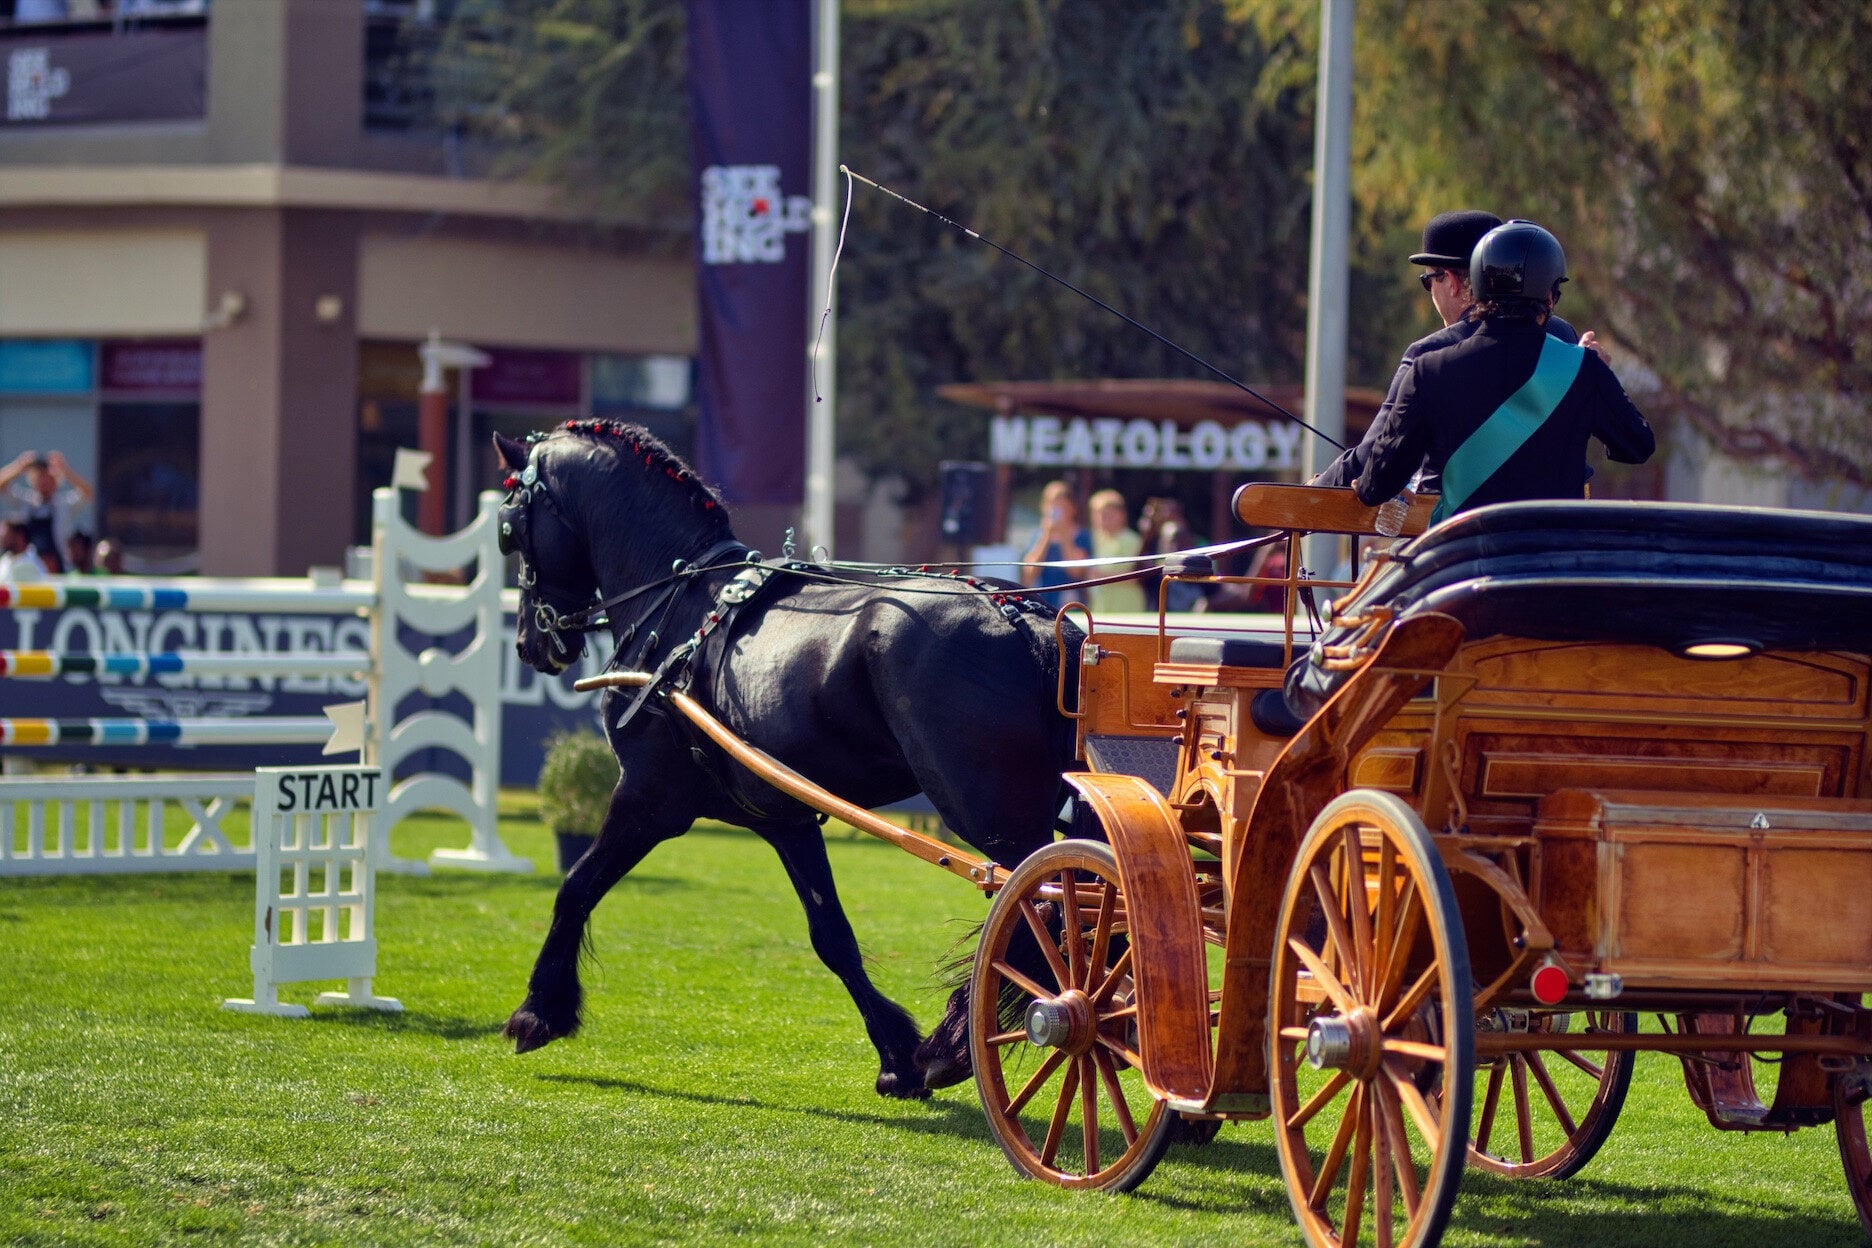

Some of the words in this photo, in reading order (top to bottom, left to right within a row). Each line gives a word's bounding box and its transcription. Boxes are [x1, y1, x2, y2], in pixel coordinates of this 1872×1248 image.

[990, 416, 1300, 469] MEATOLOGY
[12, 608, 371, 696] LONGINES
[277, 773, 380, 811] START
